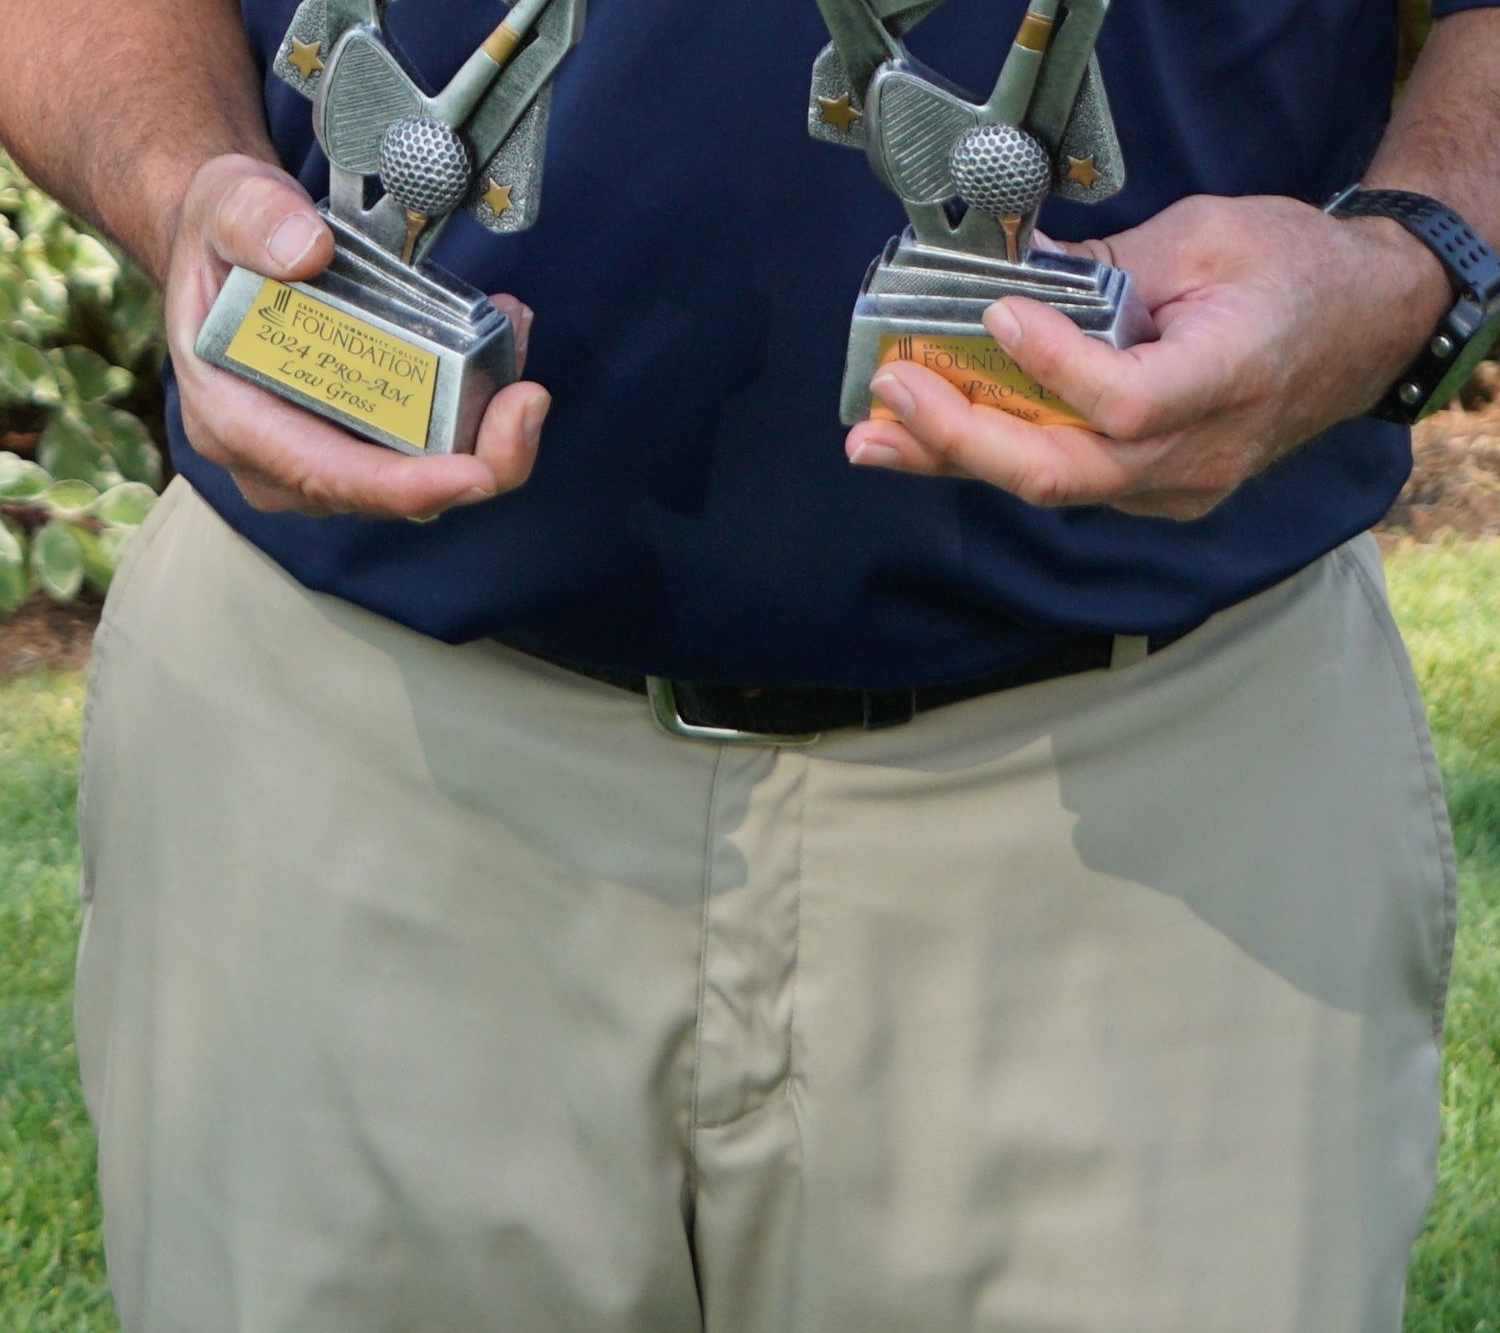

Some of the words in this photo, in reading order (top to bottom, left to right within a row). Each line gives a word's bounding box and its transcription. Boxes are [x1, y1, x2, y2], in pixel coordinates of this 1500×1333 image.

[256, 324, 312, 359] 2024
[292, 309, 428, 385] FOUNDATION
[298, 302, 334, 323] CENTRAL
[338, 321, 389, 348] COMMUNITY
[392, 346, 430, 367] COLLEGE
[279, 360, 323, 388] Low
[326, 381, 378, 414] Gross
